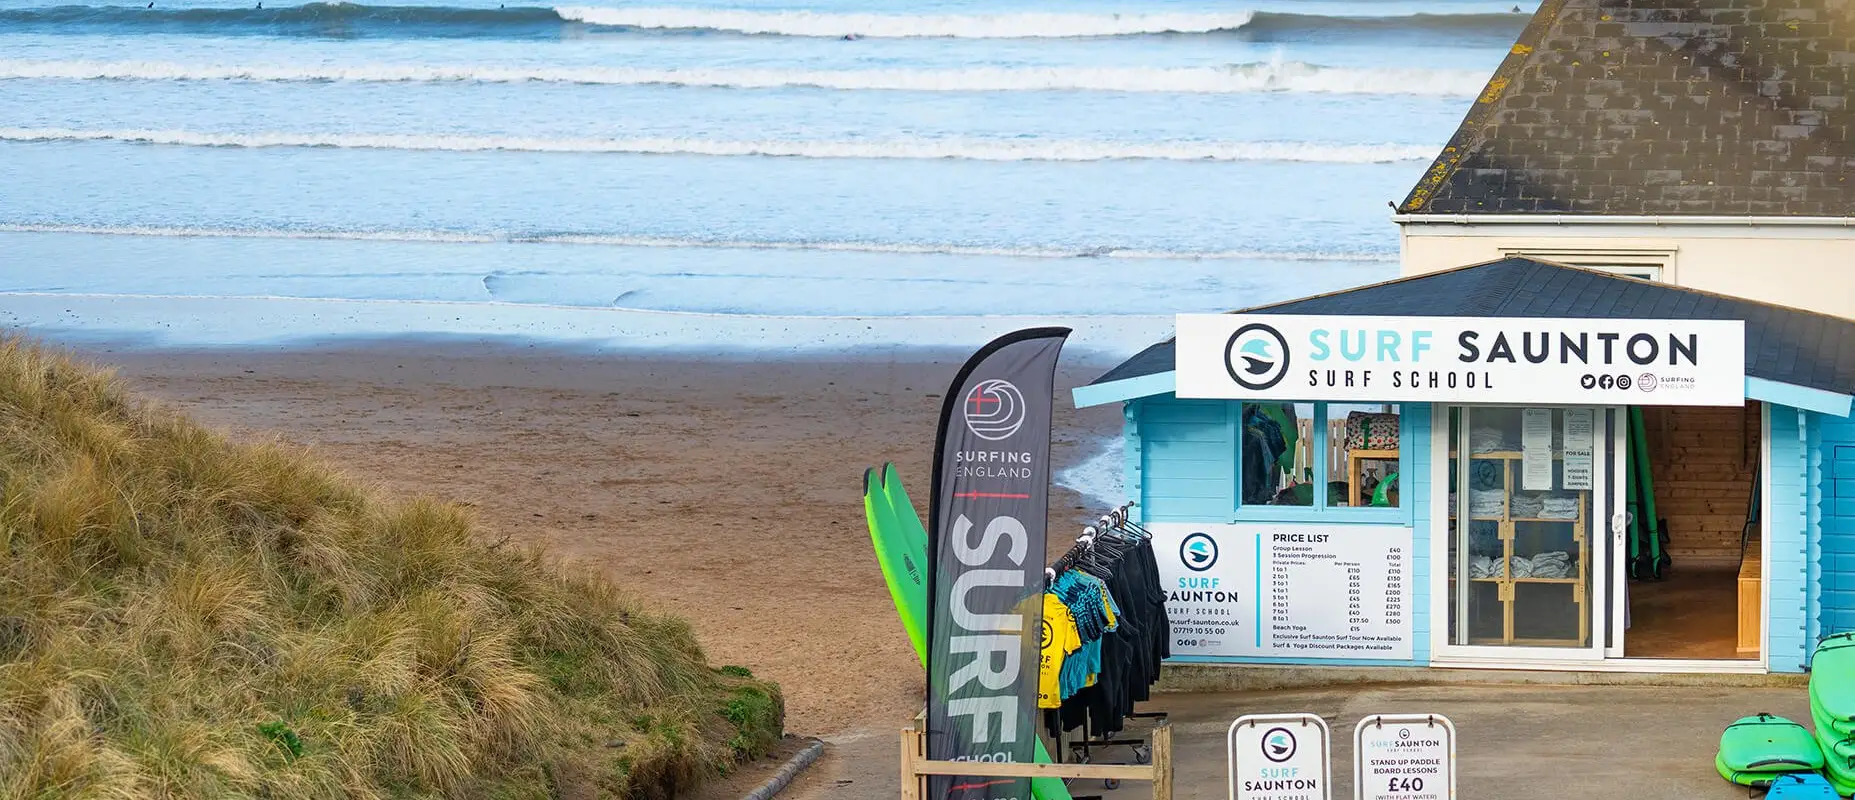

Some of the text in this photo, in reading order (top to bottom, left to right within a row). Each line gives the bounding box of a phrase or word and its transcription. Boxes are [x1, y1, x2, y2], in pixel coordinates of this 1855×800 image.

[1309, 329, 1697, 366] SURF SAUNTON
[1309, 370, 1492, 388] SURF SCHOOL
[956, 451, 1032, 463] SURFING
[956, 466, 1031, 478] ENGLAND
[1273, 534, 1329, 542] PRICE LIST
[1178, 577, 1220, 588] SURF
[948, 514, 1028, 743] SURF
[1260, 768, 1298, 778] SURF
[1245, 779, 1316, 791] SAUNTON
[1389, 777, 1423, 792] £40
